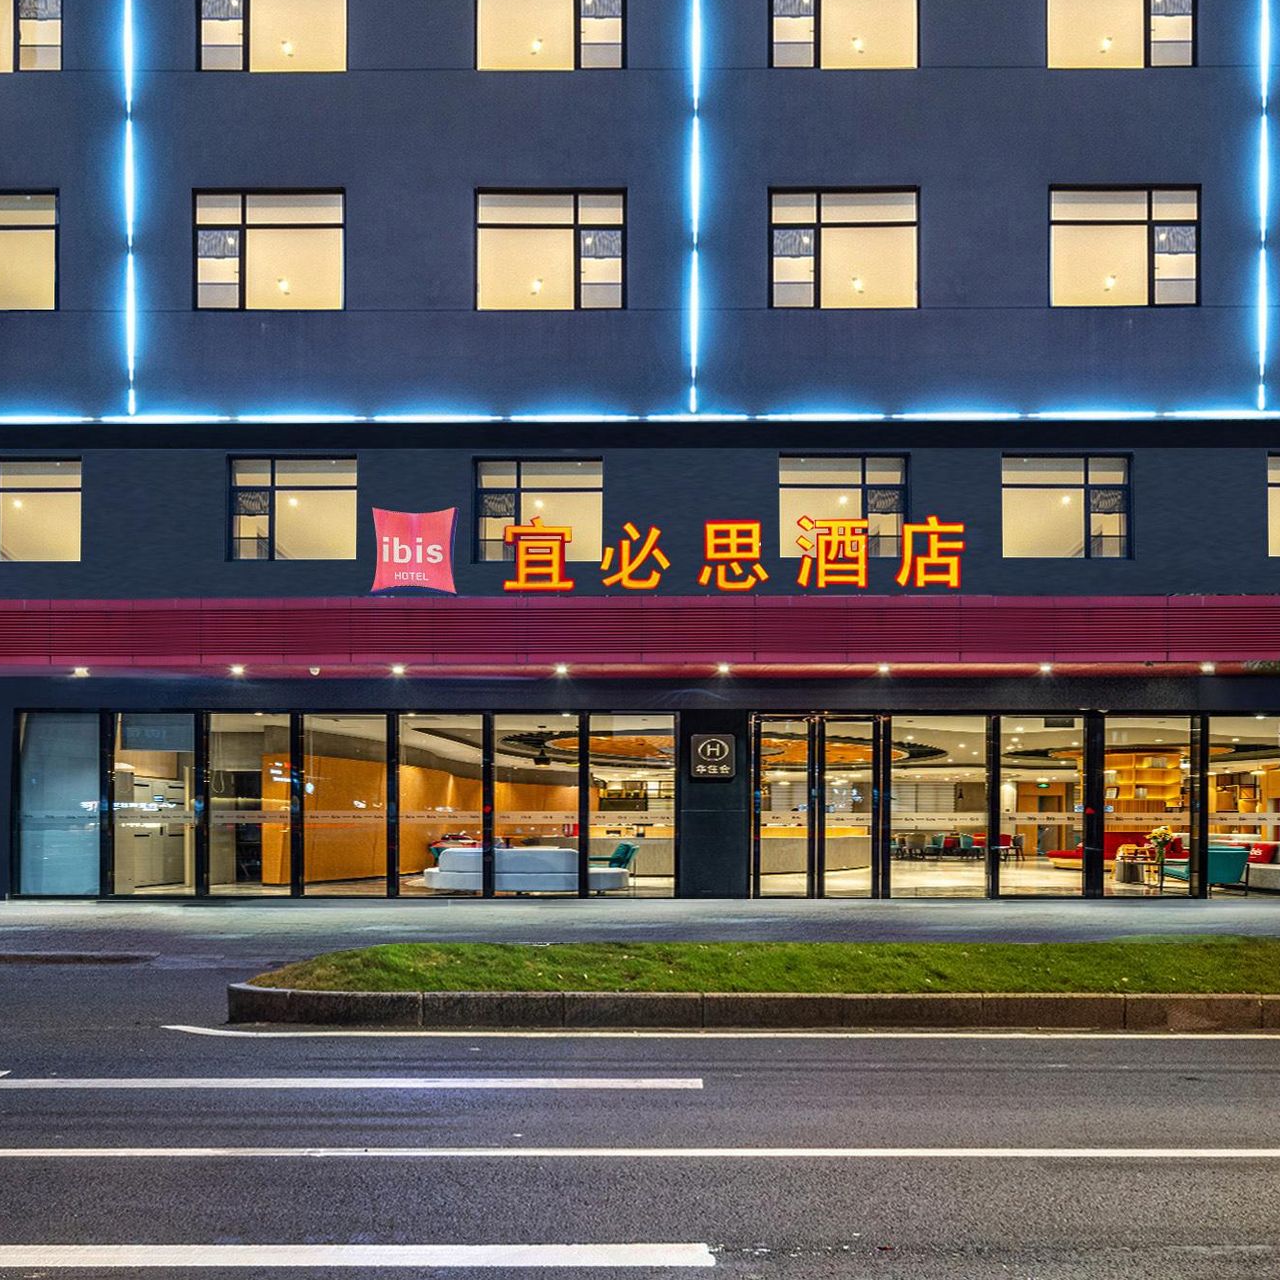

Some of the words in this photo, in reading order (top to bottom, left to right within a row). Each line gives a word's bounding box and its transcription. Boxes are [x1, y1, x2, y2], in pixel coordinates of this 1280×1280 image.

[382, 536, 444, 564] ibis
[503, 515, 967, 592] 宜必思酒店
[394, 571, 429, 581] HOTEL
[706, 743, 720, 757] H
